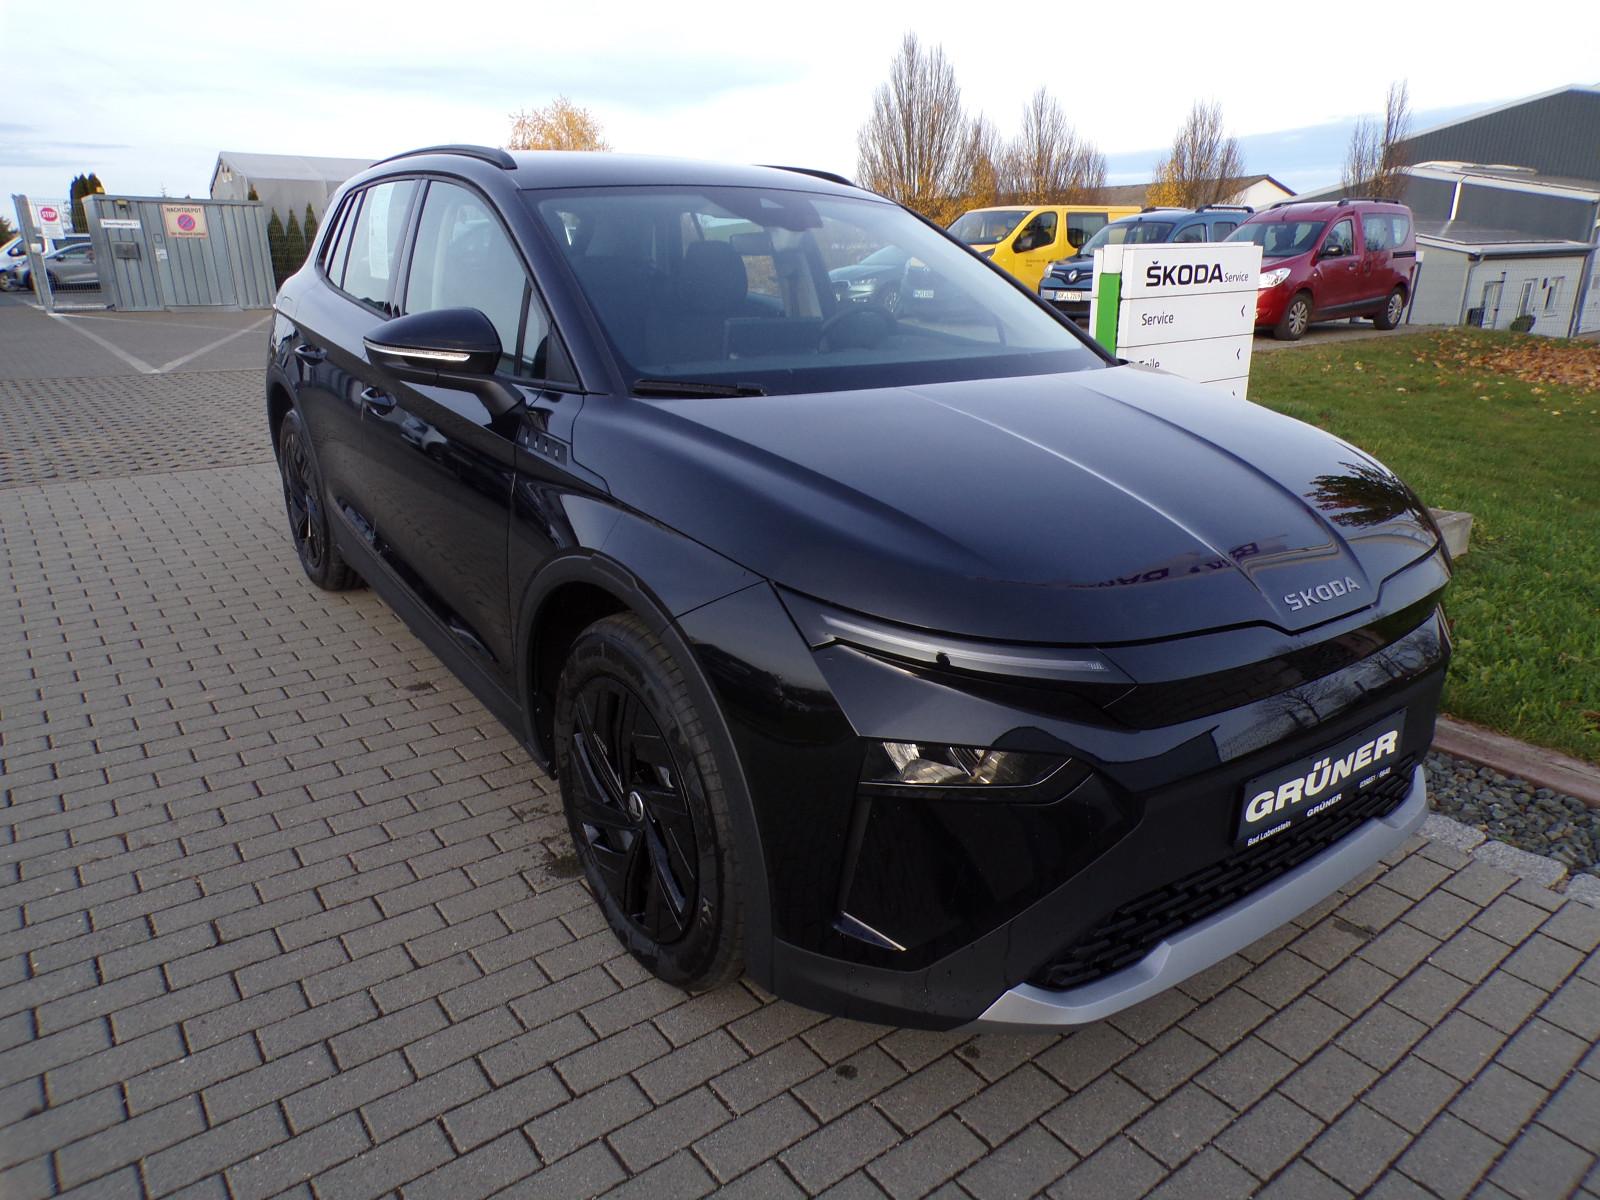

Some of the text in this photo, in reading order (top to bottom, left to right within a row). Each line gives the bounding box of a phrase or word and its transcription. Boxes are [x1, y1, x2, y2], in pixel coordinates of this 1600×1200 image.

[42, 210, 57, 218] STOP
[1146, 261, 1249, 287] ŠKODA Service
[1141, 312, 1174, 326] Service
[1245, 730, 1398, 823] GRÜNER
[1306, 793, 1342, 817] GRÜNER
[1247, 835, 1260, 846] Bad
